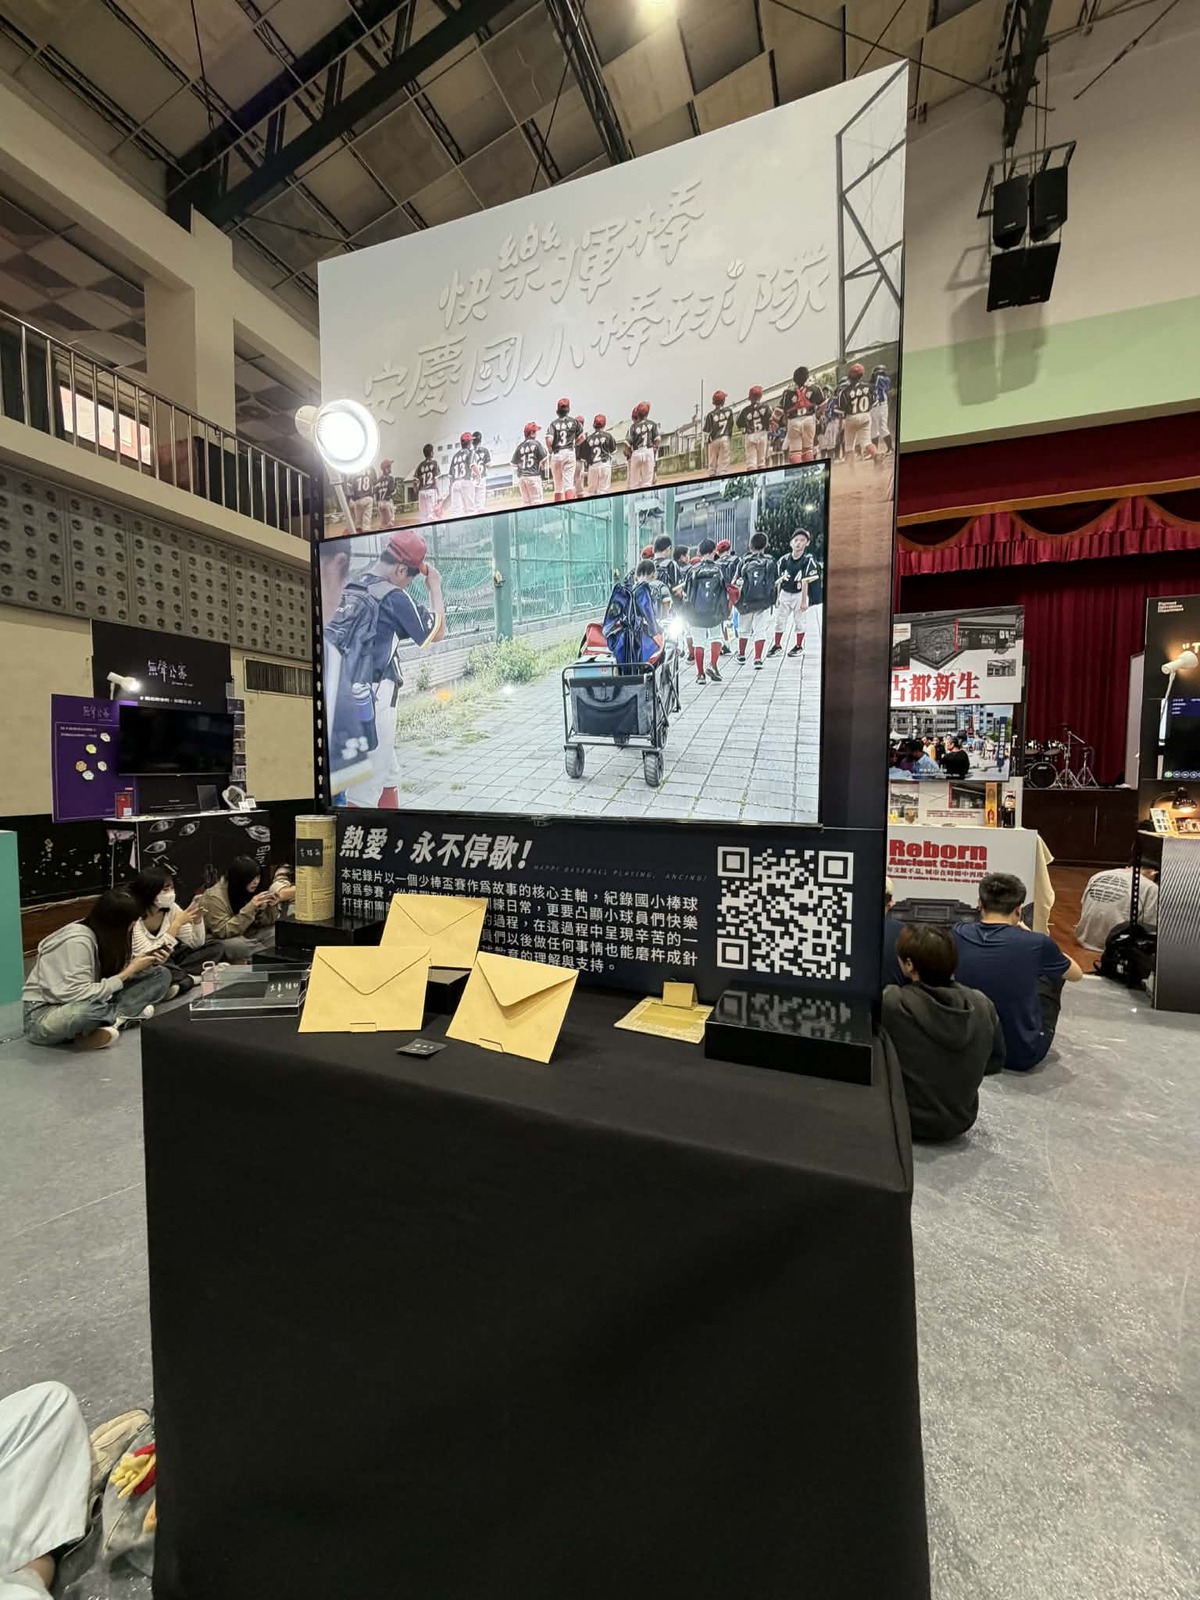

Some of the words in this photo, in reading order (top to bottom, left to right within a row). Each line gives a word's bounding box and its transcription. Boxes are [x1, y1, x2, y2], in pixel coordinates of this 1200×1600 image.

[438, 180, 705, 330] 快樂揮棒
[364, 244, 829, 425] 安慶國小棒球隊
[850, 396, 870, 413] 10
[718, 421, 727, 434] 7
[558, 430, 567, 446] 3
[520, 454, 534, 469] 15
[593, 447, 602, 462] 2
[453, 464, 466, 477] 13
[357, 476, 370, 491] 18
[421, 472, 434, 485] 12
[339, 825, 533, 871] 熱愛，永不停歇！
[889, 839, 988, 861] Reborn
[889, 857, 937, 868] Ancient
[940, 859, 987, 871] Capital
